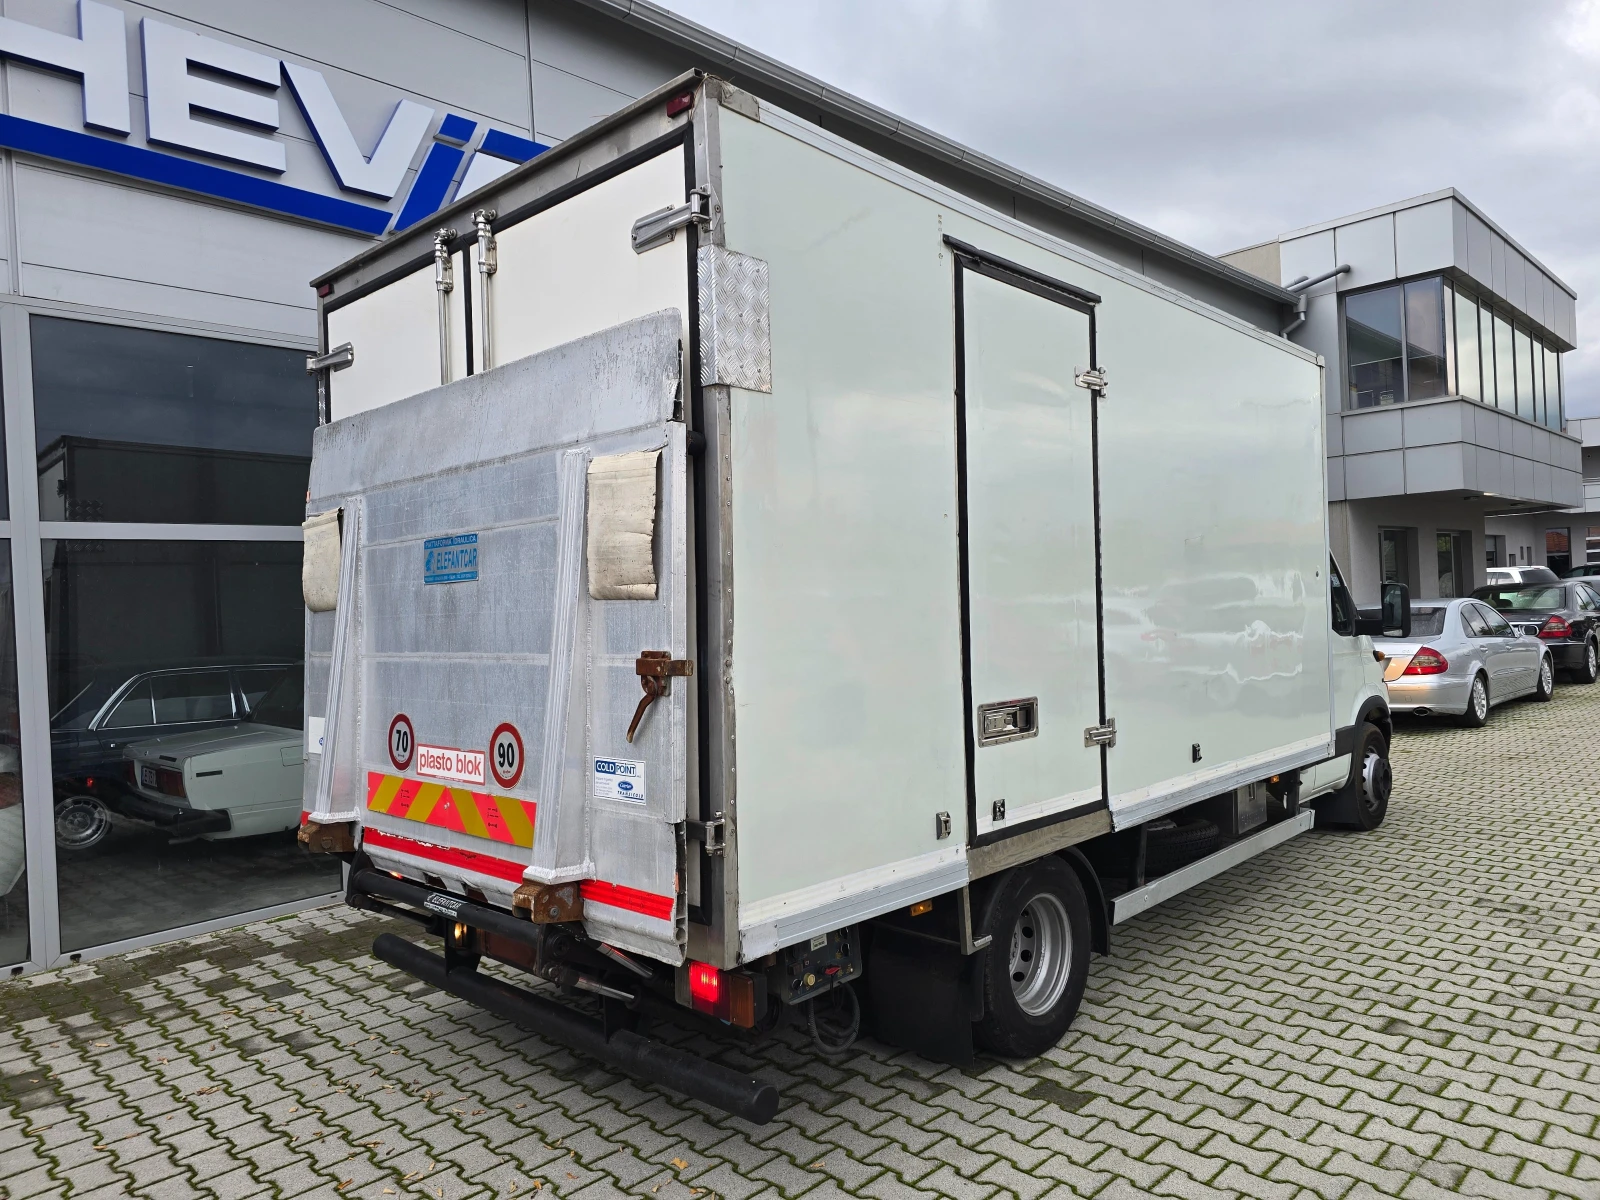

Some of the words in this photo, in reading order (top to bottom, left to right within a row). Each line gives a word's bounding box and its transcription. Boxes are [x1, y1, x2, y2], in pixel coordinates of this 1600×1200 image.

[436, 548, 478, 570] ELEFANTCAR
[396, 729, 409, 753] 70
[419, 750, 453, 772] plasto
[456, 753, 482, 776] blok
[498, 742, 515, 768] 90
[596, 762, 615, 773] COLD
[616, 763, 636, 775] POINT
